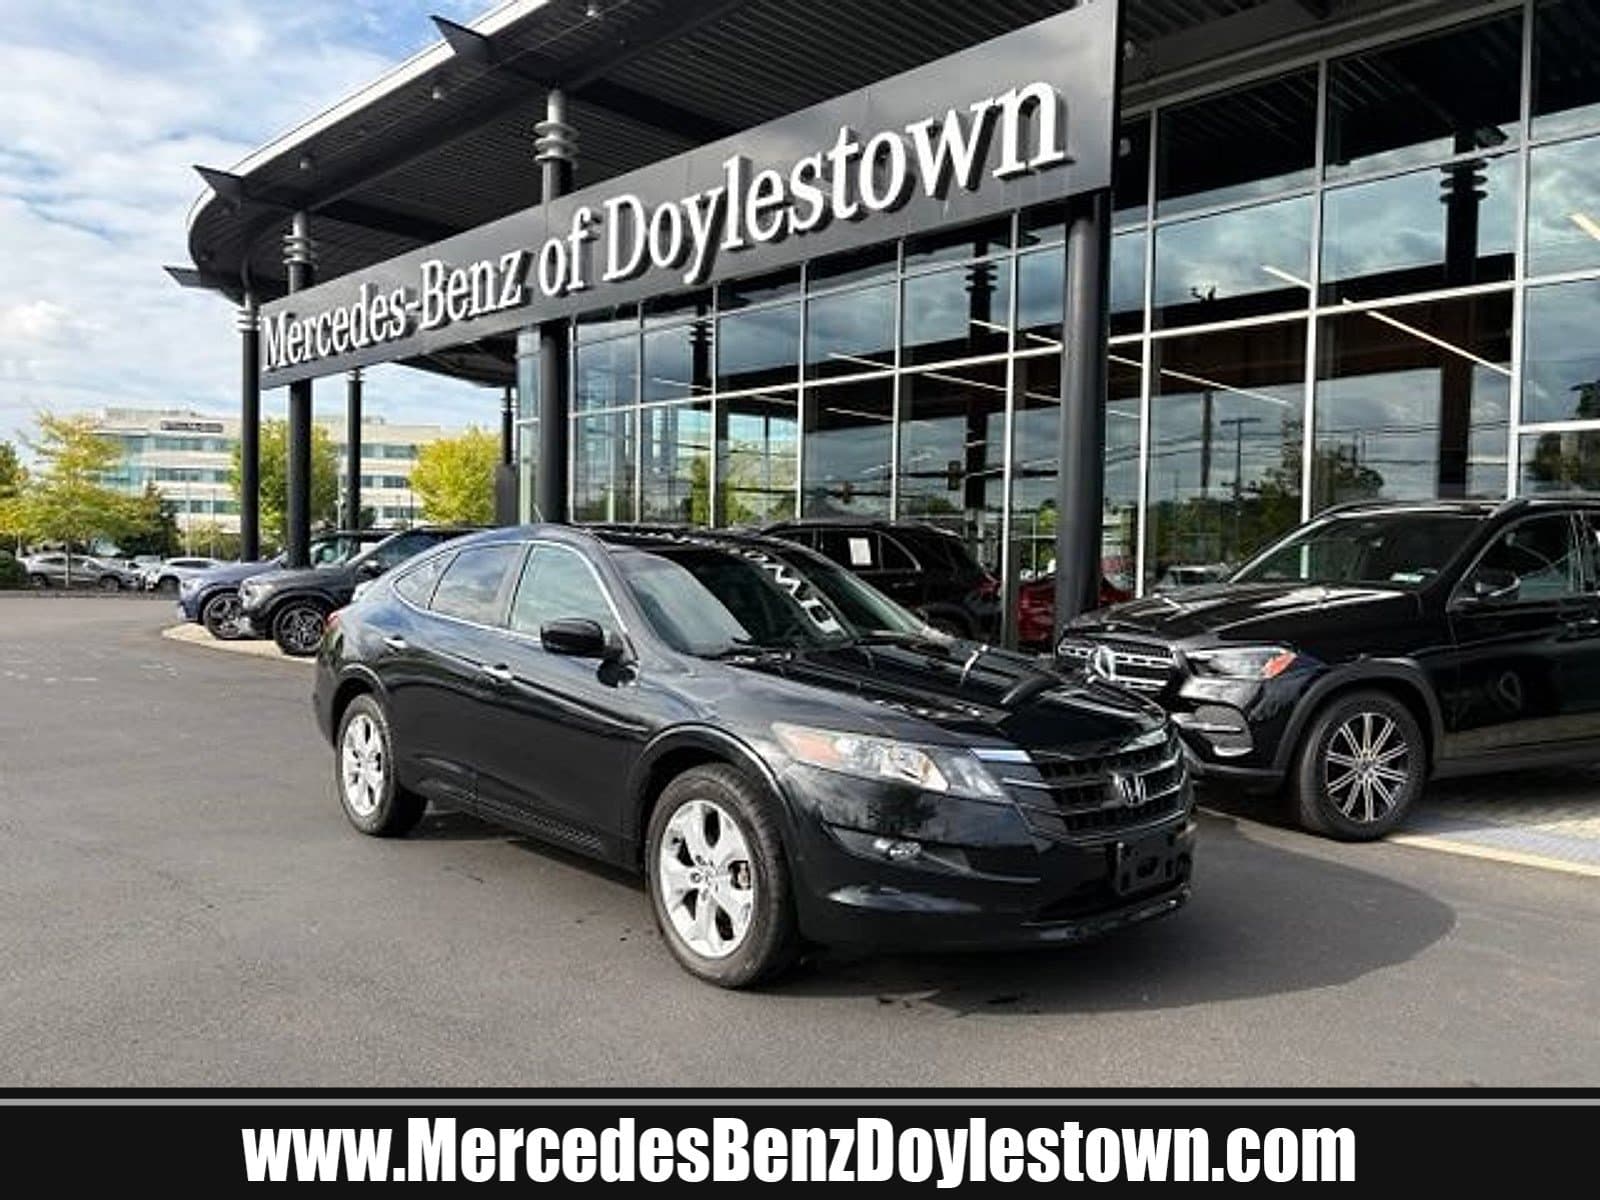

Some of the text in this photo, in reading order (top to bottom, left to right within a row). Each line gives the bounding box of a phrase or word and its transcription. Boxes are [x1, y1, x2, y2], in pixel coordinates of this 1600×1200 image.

[260, 80, 1068, 374] Mercedes-Benz of Doylestown
